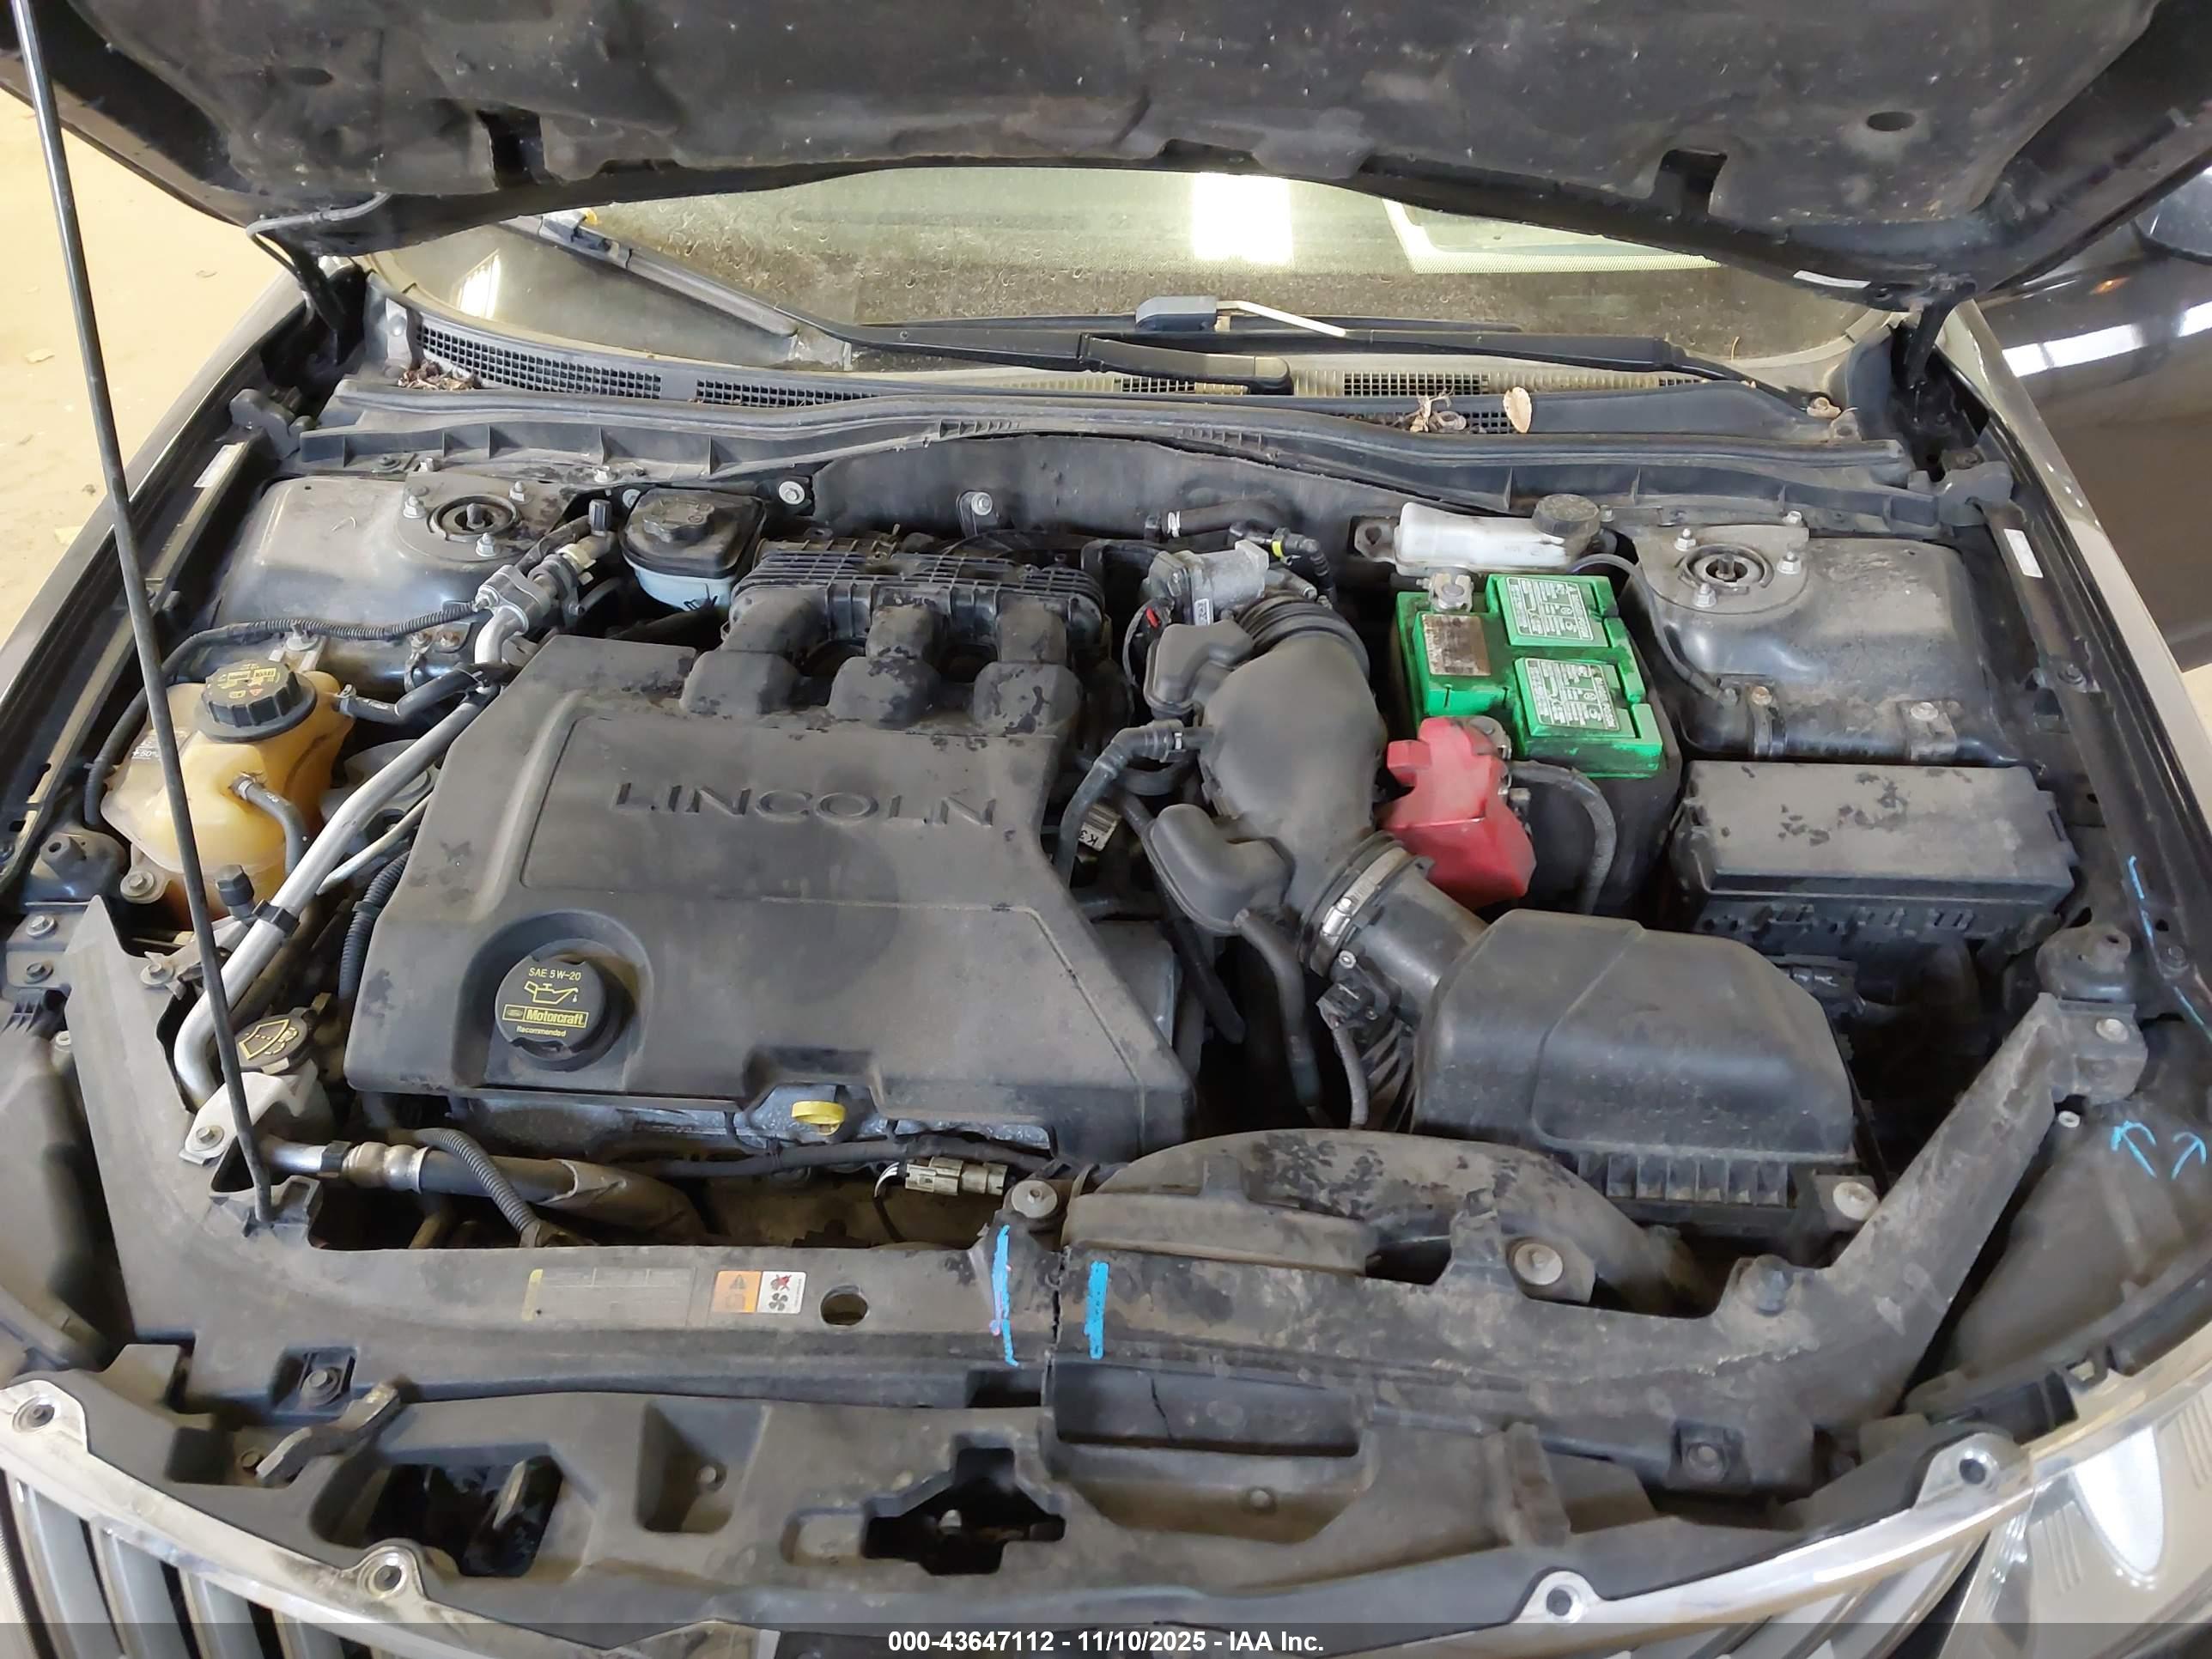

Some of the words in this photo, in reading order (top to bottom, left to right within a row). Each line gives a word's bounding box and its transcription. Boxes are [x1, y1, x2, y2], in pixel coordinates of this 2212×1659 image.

[616, 781, 996, 828] LINCOLN
[528, 967, 548, 978] SAE
[549, 969, 582, 981] 5W-20
[526, 1008, 583, 1025] Motorcraft
[516, 1024, 567, 1037] Recommended
